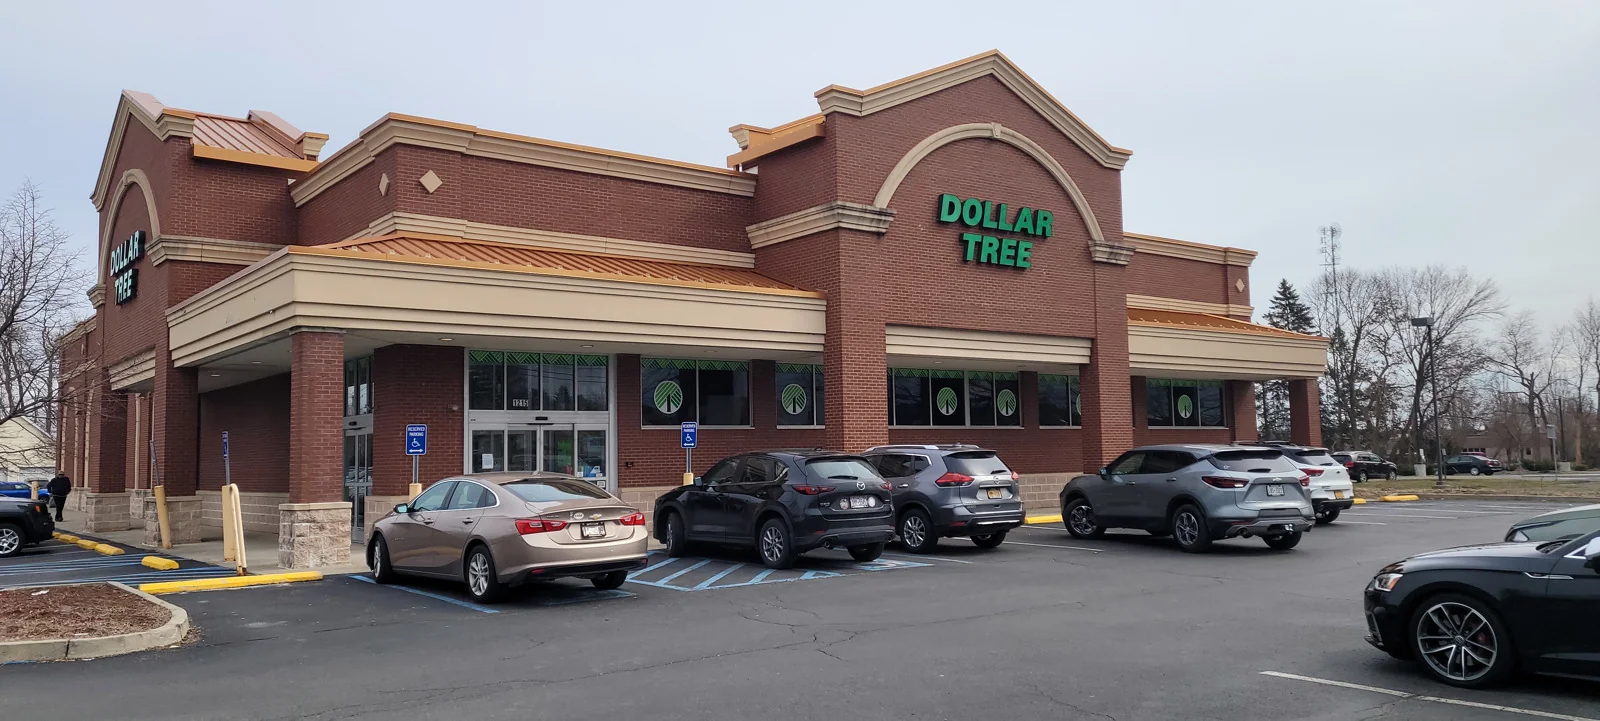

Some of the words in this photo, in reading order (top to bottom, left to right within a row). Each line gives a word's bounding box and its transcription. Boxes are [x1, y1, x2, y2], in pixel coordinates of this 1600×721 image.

[940, 193, 1054, 237] DOLLAR
[110, 230, 140, 277] DOLLAR
[963, 232, 1033, 268] TREE
[114, 268, 133, 306] TREE
